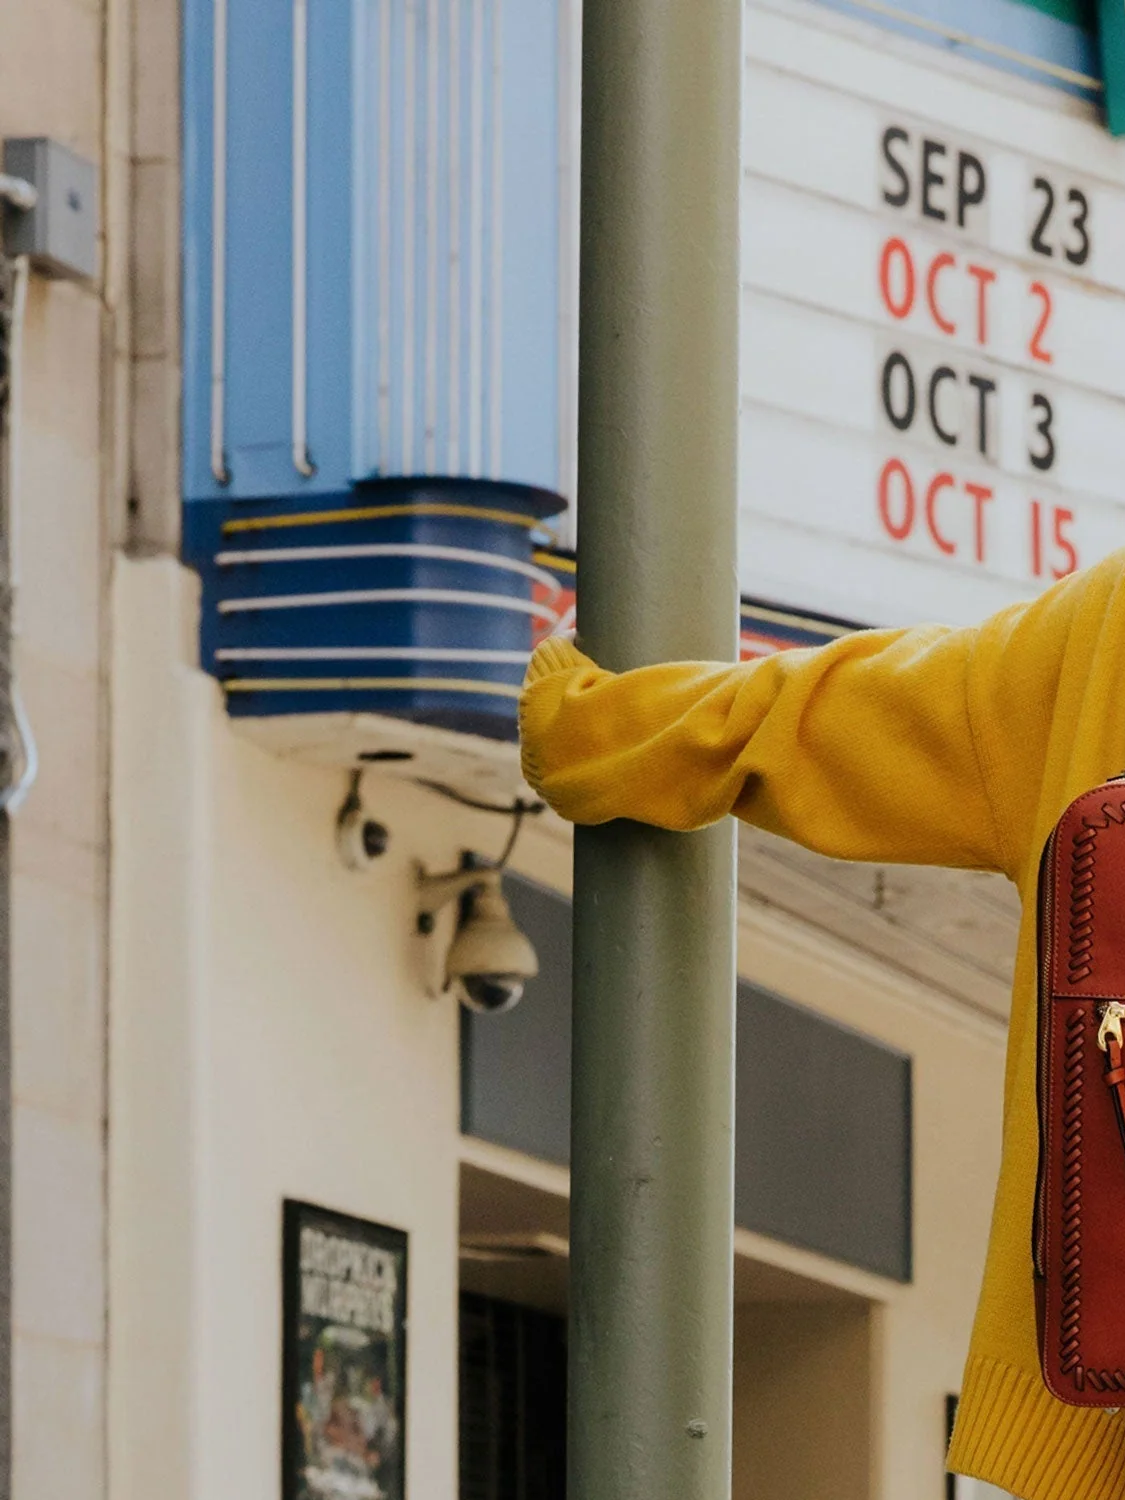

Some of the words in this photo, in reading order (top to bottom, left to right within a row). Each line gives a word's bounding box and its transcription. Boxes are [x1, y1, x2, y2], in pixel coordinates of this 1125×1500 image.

[880, 126, 986, 228] SEP
[1028, 177, 1090, 265] 23
[879, 238, 996, 345] OCT
[1026, 282, 1054, 364] 2
[881, 352, 997, 455] OCT
[1028, 394, 1056, 470] 3
[878, 459, 993, 562] OCT
[1030, 500, 1079, 580] 15
